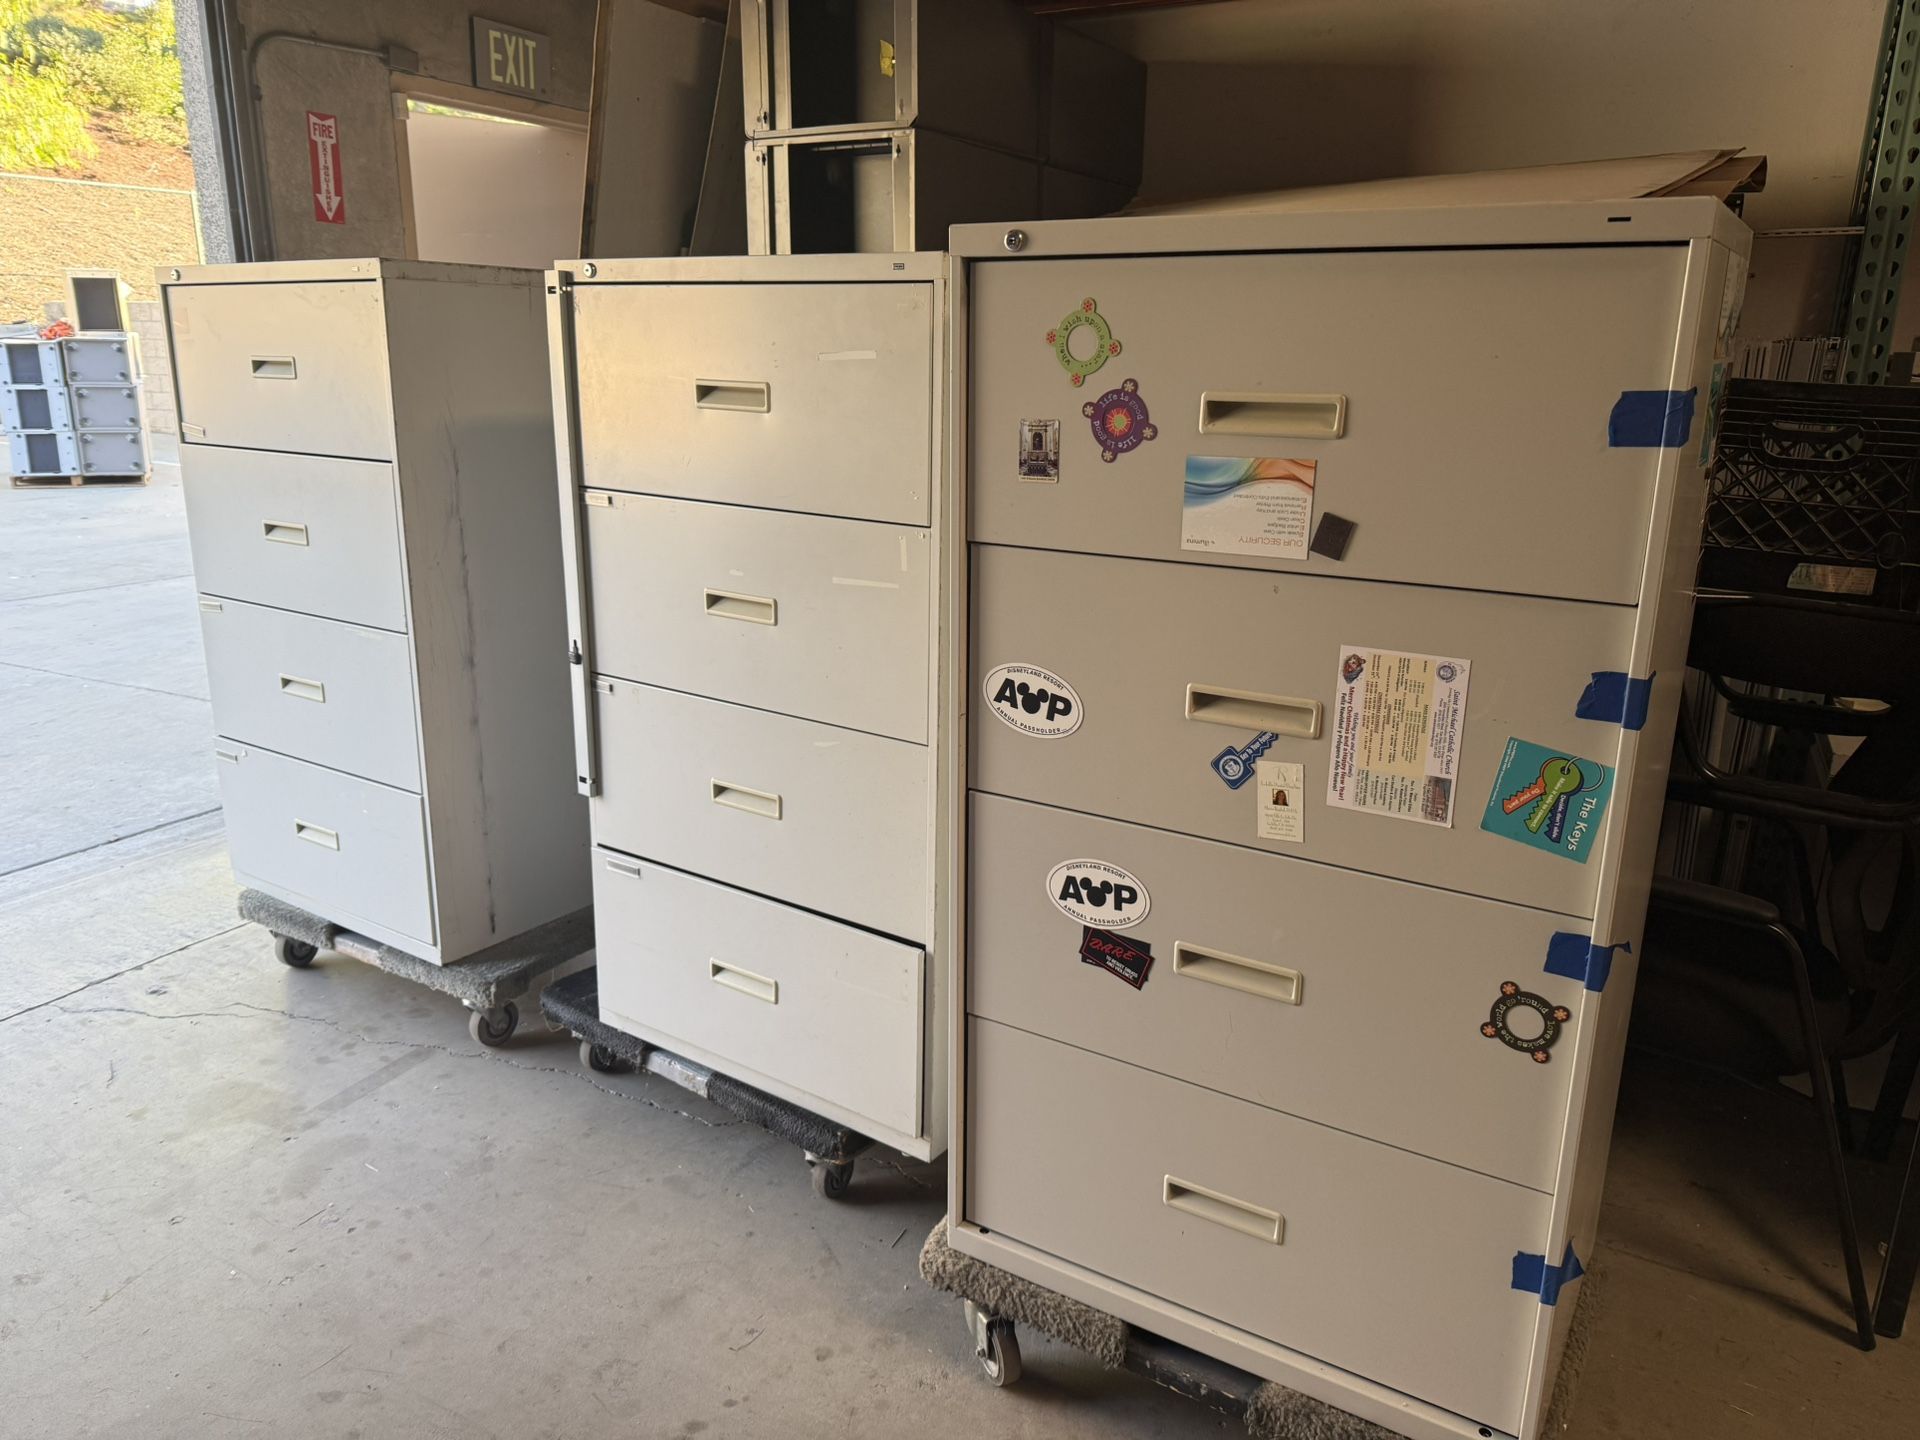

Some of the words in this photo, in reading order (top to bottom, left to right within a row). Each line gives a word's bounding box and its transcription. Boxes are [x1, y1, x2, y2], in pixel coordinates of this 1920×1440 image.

[489, 30, 536, 89] EXIT
[312, 122, 334, 139] FIRE
[321, 141, 332, 213] EXTINGUISHER
[1063, 315, 1082, 331] wish
[1099, 393, 1118, 408] life
[1120, 392, 1129, 402] is
[1129, 400, 1144, 420] good
[1093, 420, 1107, 440] good
[1117, 435, 1136, 449] life
[1238, 535, 1282, 546] SECURITY
[1284, 538, 1304, 547] OUR
[1007, 667, 1042, 678] DISNEYLAND
[1043, 675, 1064, 690] RESORT
[1346, 686, 1355, 705] Merry
[1452, 690, 1460, 706] Saint
[996, 706, 1018, 725] ANNUAL
[1020, 722, 1061, 734] PASSHOLDER
[1338, 706, 1346, 729] Navidad
[1345, 705, 1353, 735] Christmas
[1351, 712, 1359, 732] Wishing
[1450, 707, 1459, 730] Michael
[1335, 734, 1343, 759] Próspero
[1447, 730, 1456, 754] Catholic
[1340, 751, 1348, 771] Happy
[1346, 761, 1355, 778] family
[1444, 754, 1454, 775] Church
[1554, 777, 1566, 790] Make
[1545, 794, 1553, 804] safe
[1578, 795, 1598, 821] The
[1564, 820, 1587, 853] Keys
[1066, 863, 1101, 871] DISNEYLAND
[1102, 866, 1126, 880] RESORT
[1063, 904, 1087, 920] ANNUAL
[1089, 916, 1131, 925] PASSHOLDER
[1506, 998, 1517, 1007] go
[1495, 1003, 1506, 1028] world
[1501, 1030, 1515, 1043] the
[1543, 1020, 1556, 1040] love
[1517, 1038, 1545, 1049] makes
